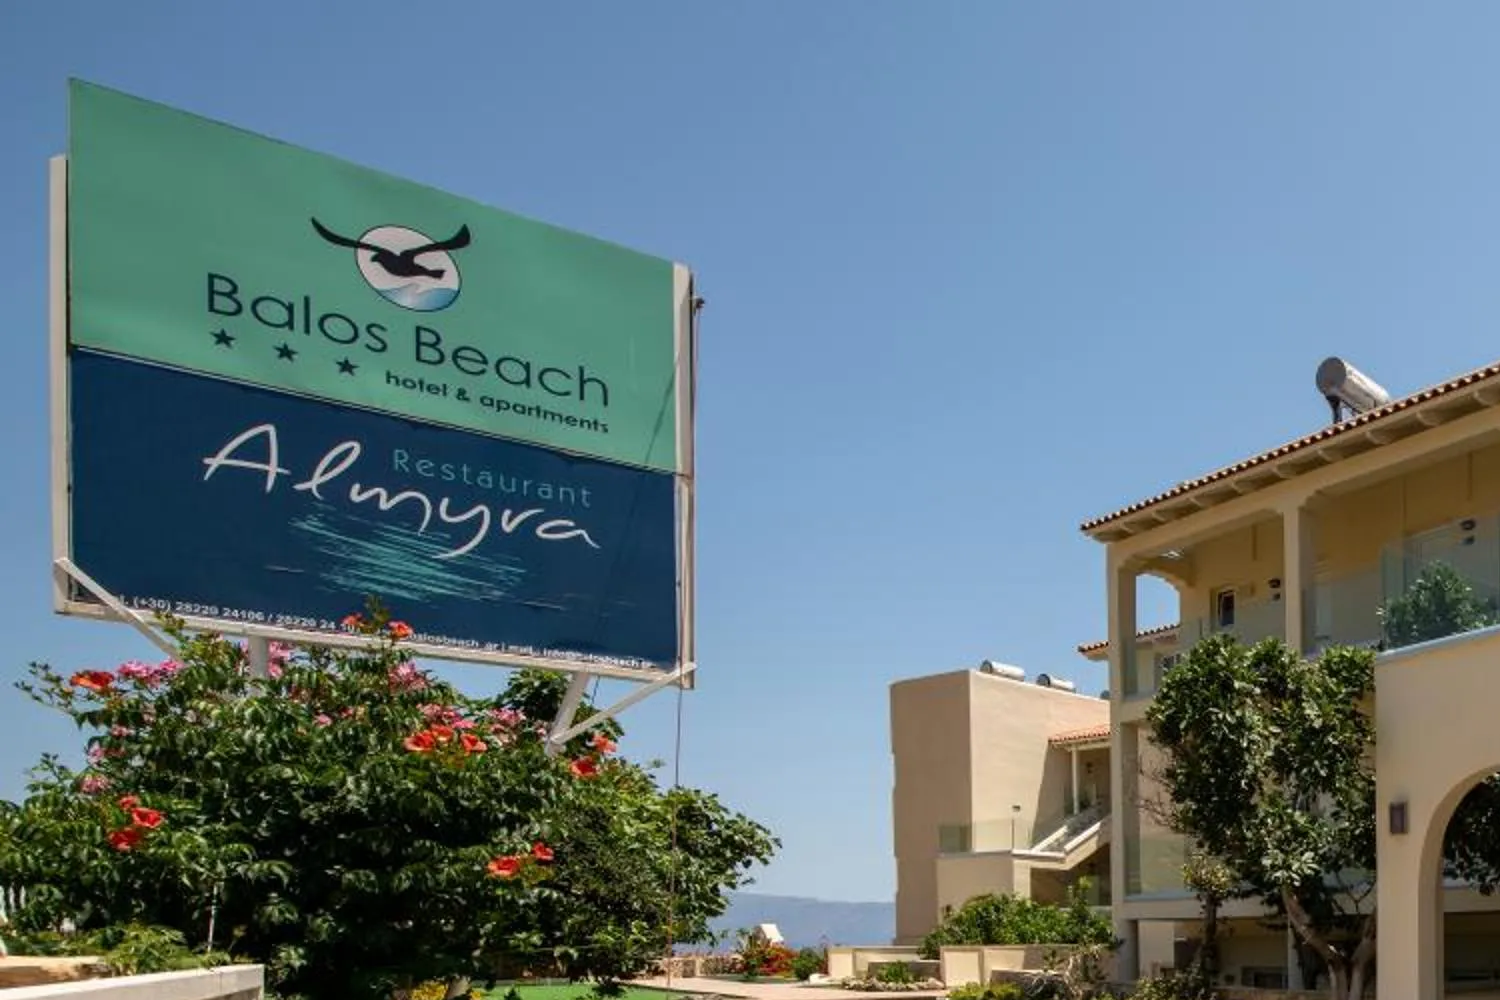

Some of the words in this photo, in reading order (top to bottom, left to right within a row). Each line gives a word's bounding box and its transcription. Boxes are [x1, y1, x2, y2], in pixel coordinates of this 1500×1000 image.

[208, 273, 388, 353] Balos
[415, 325, 608, 407] Beach
[386, 370, 447, 396] hotel
[456, 387, 471, 402] &
[480, 394, 608, 433] apartments
[203, 423, 600, 559] Almyra
[393, 450, 592, 508] Restaurant
